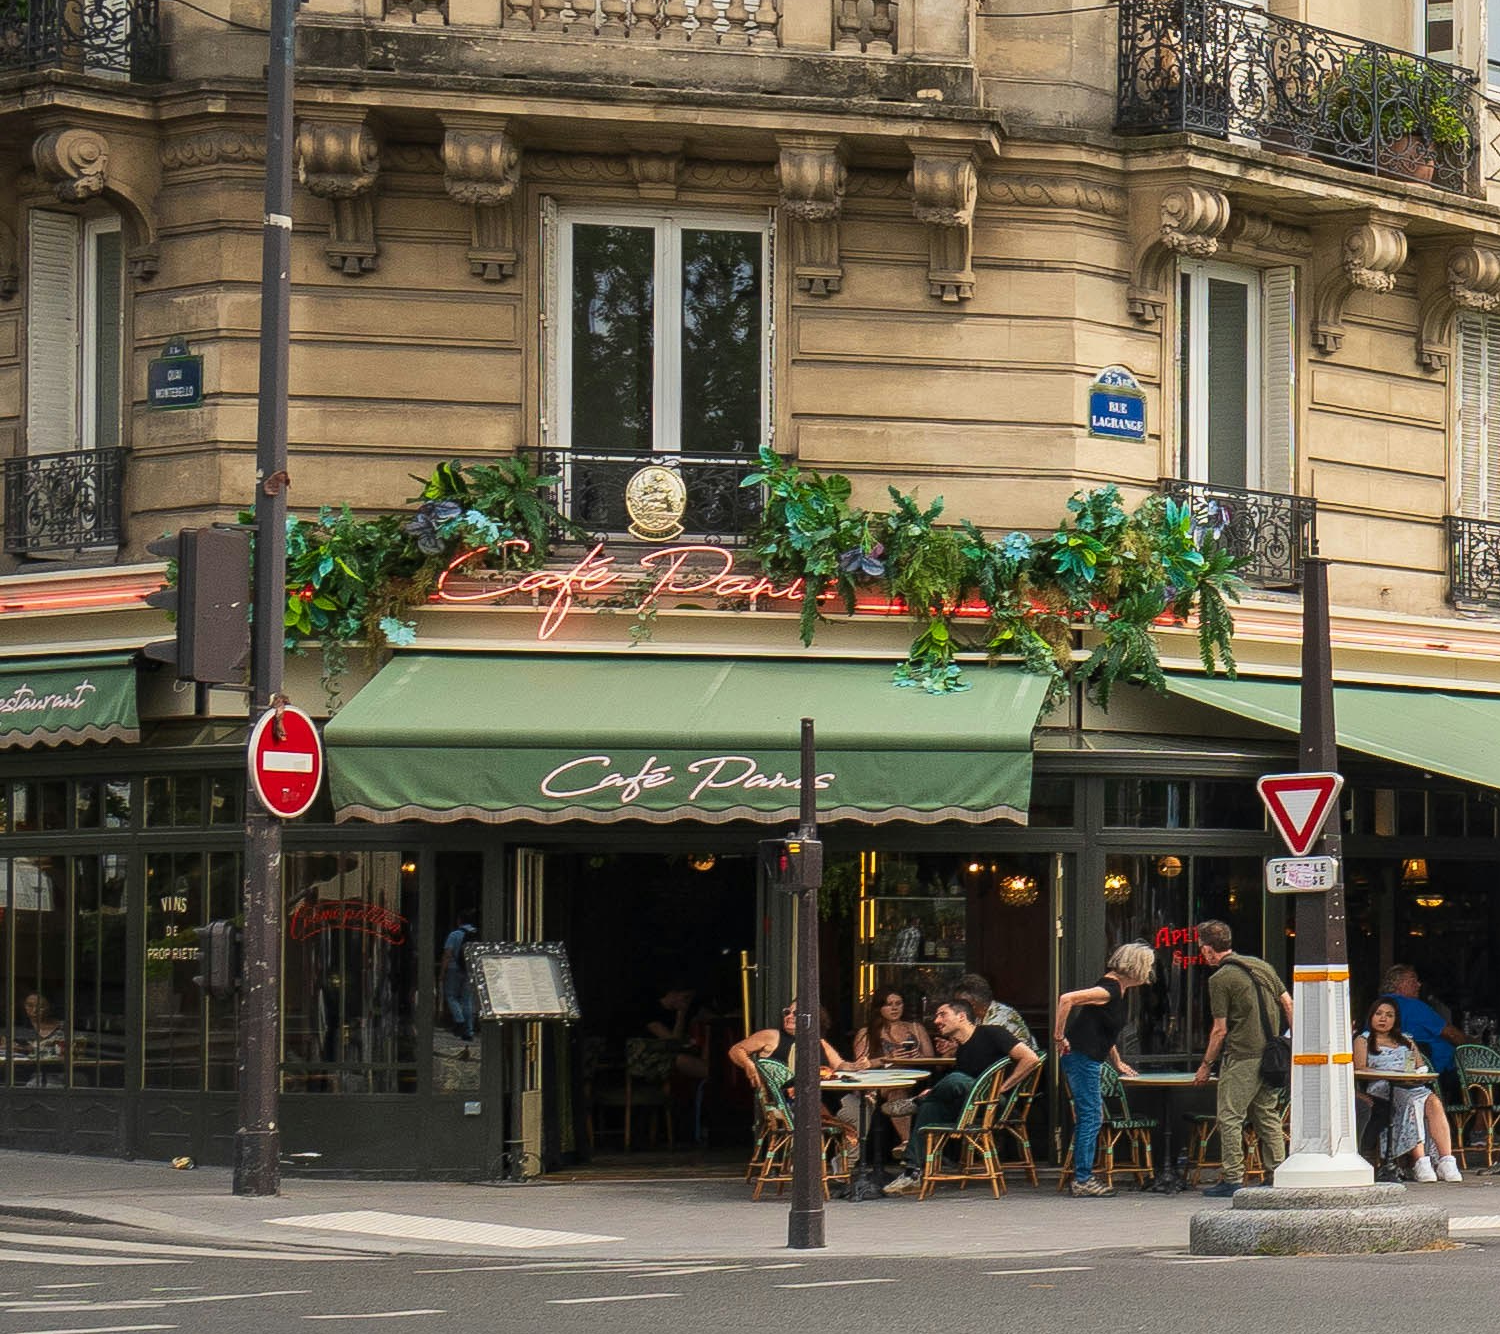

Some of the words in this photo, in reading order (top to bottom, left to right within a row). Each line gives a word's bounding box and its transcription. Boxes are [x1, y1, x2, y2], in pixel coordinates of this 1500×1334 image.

[1108, 401, 1128, 414] RUE
[1092, 415, 1144, 432] LAGRANGE
[438, 540, 623, 641] Café
[540, 755, 676, 804] Café
[160, 896, 188, 913] VINS
[166, 925, 179, 937] DE
